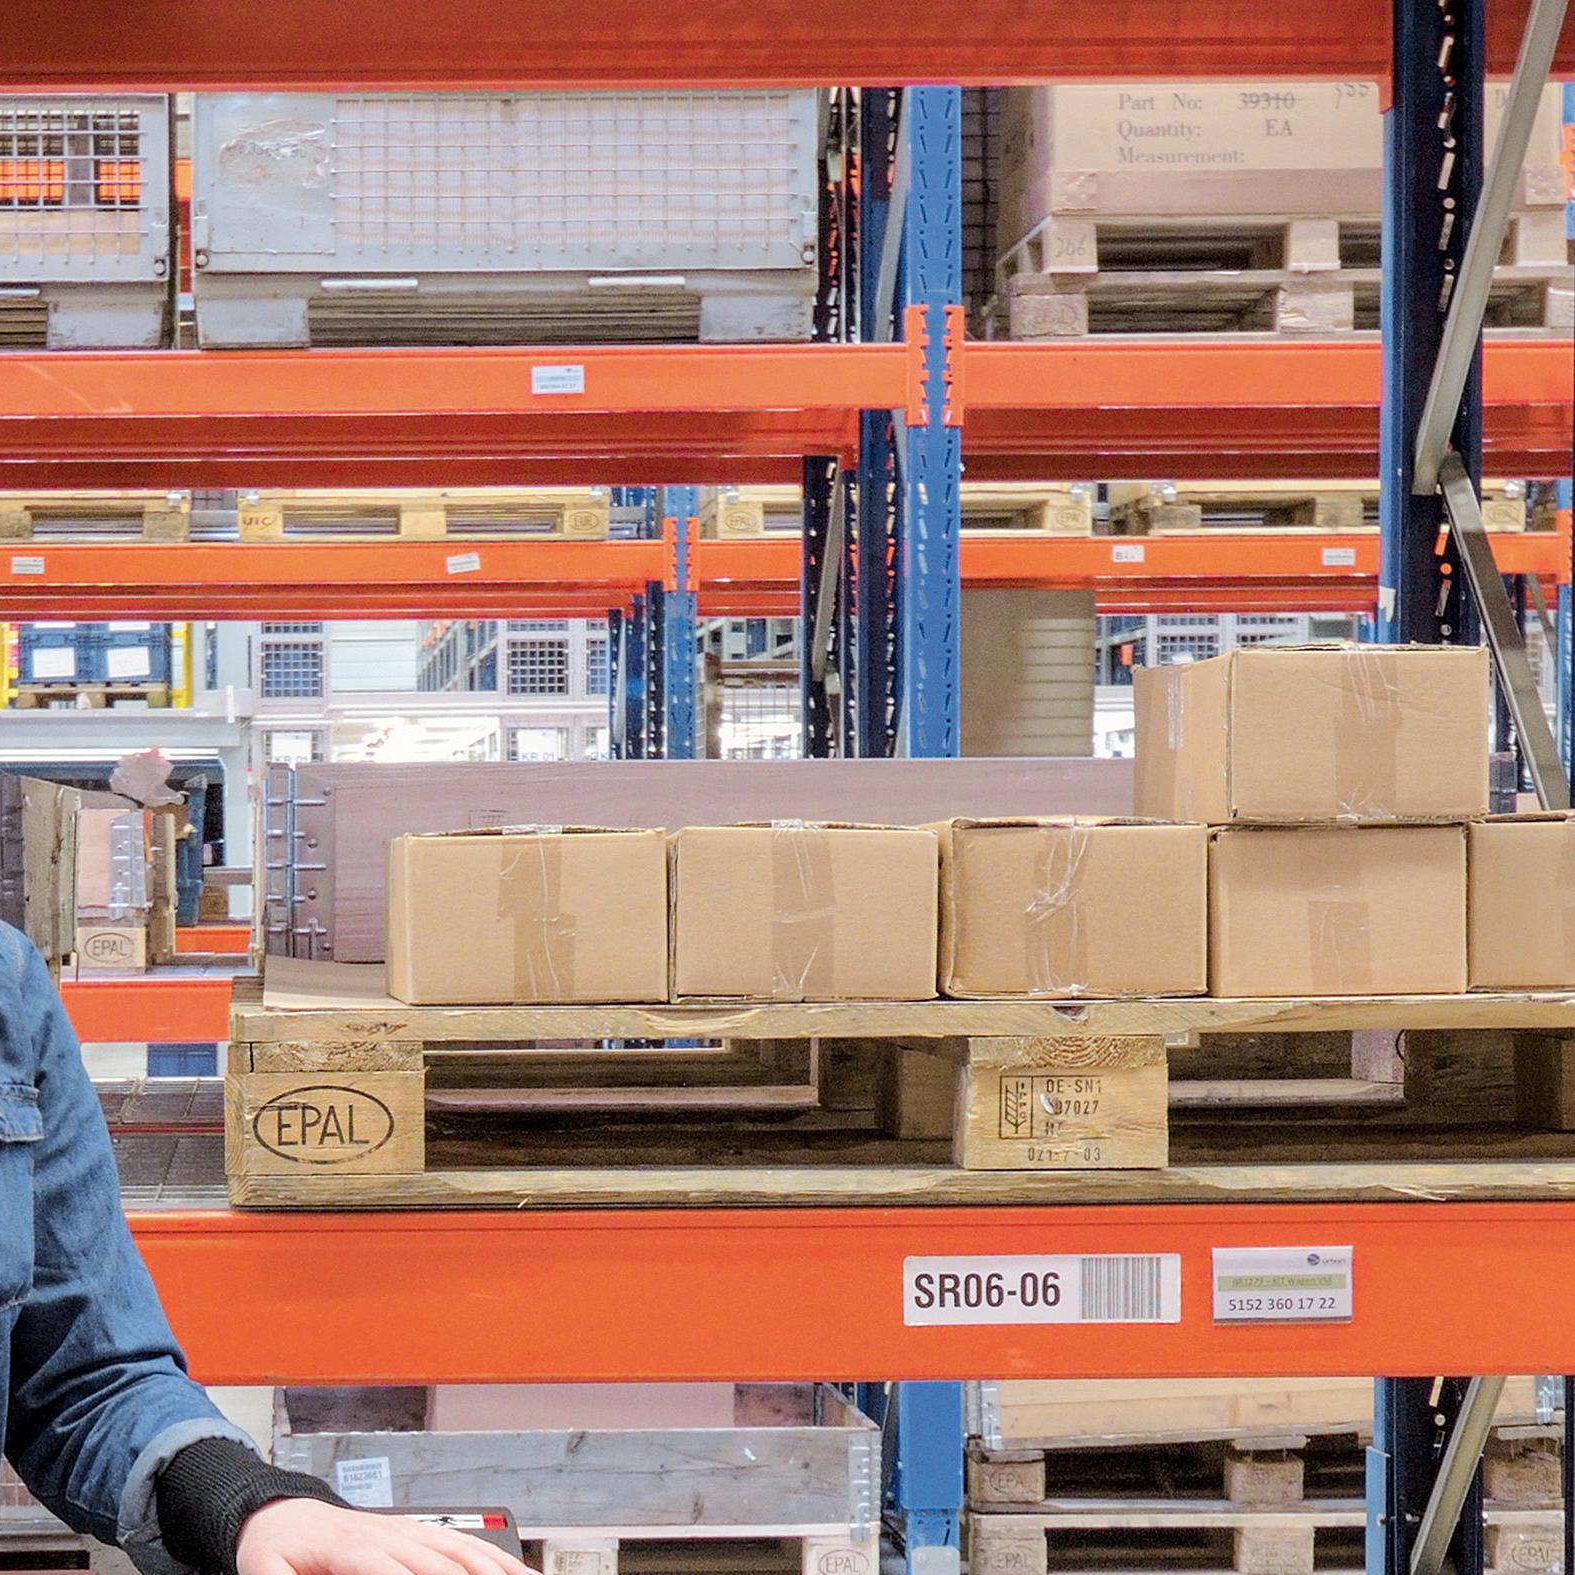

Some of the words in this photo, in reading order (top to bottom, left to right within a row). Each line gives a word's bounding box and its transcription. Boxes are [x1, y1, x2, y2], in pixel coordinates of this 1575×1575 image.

[1117, 92, 1155, 111] Part
[1172, 92, 1203, 111] No:
[1117, 119, 1202, 140] Quantity:
[1264, 118, 1294, 138] EA
[1117, 146, 1246, 165] Measurement:
[91, 939, 129, 957] EPAL
[276, 1104, 370, 1146] EPAL
[913, 1271, 1062, 1309] SR06-06
[1228, 1298, 1263, 1311] 5152
[1267, 1297, 1293, 1310] 360
[1298, 1297, 1314, 1310] 17
[1318, 1296, 1336, 1309] 22
[825, 1555, 861, 1574] EPAL
